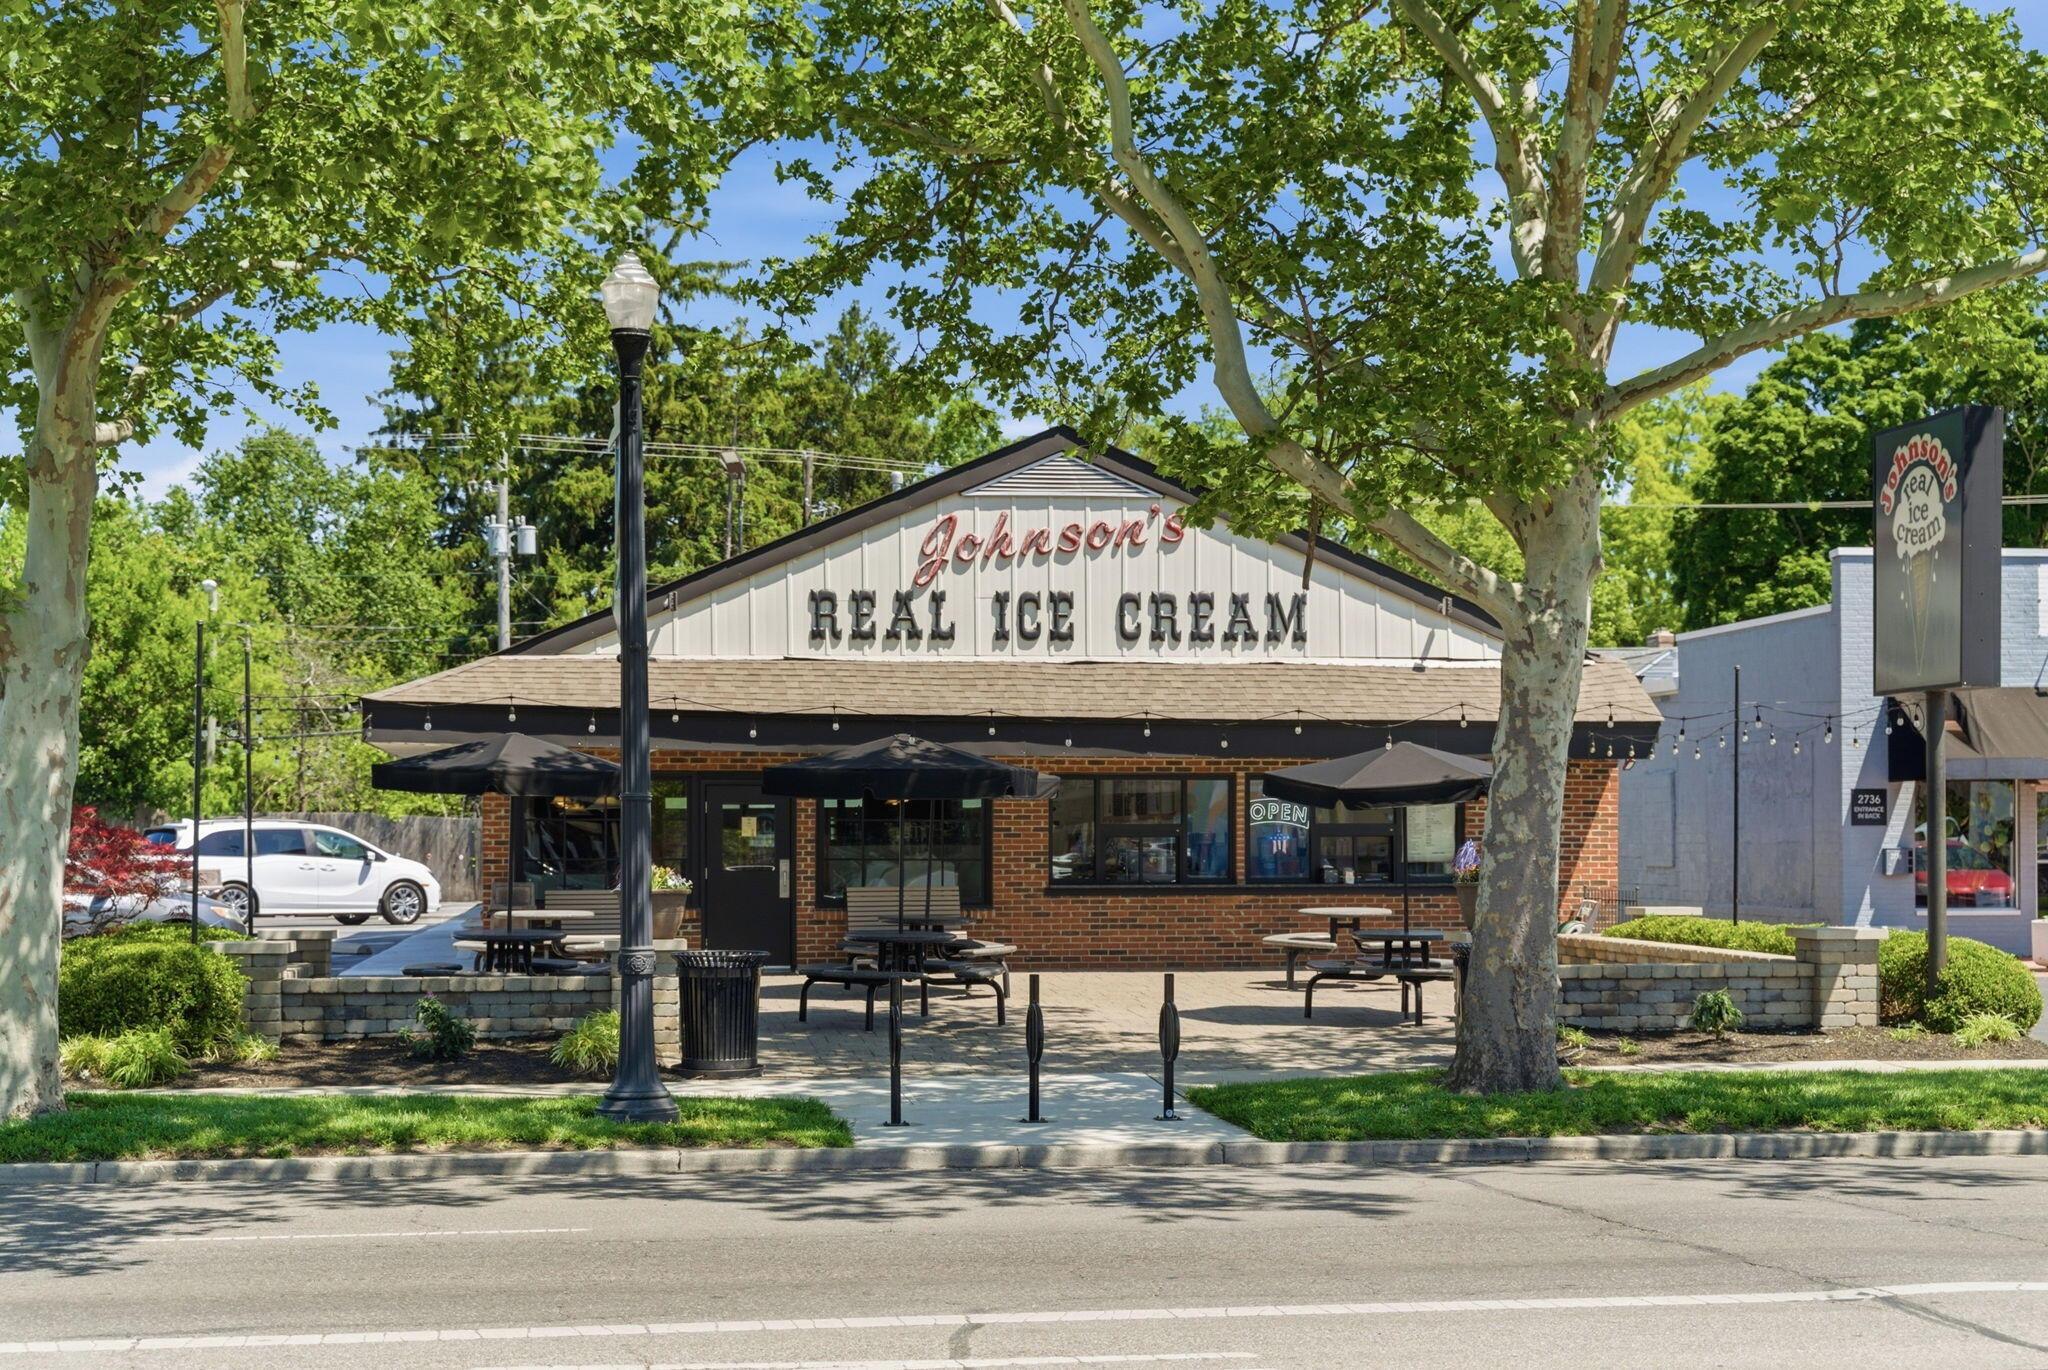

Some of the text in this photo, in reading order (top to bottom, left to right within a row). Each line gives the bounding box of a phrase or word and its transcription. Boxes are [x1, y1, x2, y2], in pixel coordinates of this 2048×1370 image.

[1881, 439, 1955, 514] Johnson's
[1903, 473, 1934, 501] real
[1908, 501, 1929, 524] ice
[914, 503, 1186, 588] Johnson's
[1896, 516, 1942, 546] cream
[808, 589, 1309, 643] REAL ICE CREAM
[1250, 802, 1308, 823] OPEN
[1857, 794, 1881, 805] 2736
